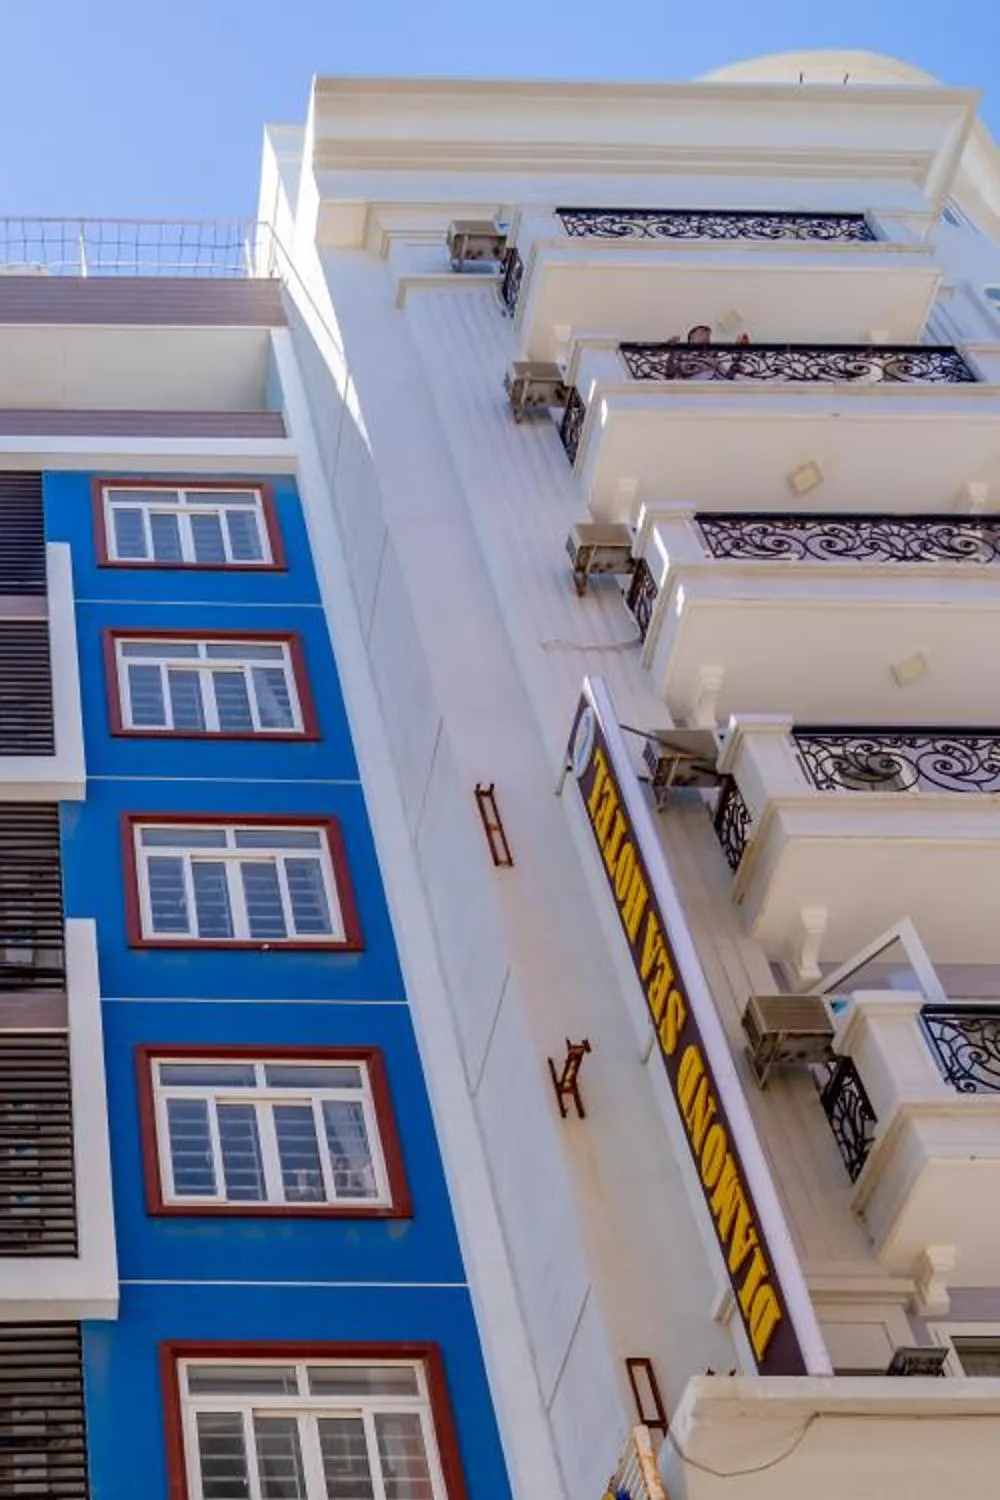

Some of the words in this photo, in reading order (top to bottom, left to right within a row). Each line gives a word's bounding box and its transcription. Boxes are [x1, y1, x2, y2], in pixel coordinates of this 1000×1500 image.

[587, 747, 649, 945] HOTEL
[640, 911, 687, 1056] SEA
[677, 1045, 782, 1363] DIAMOND
